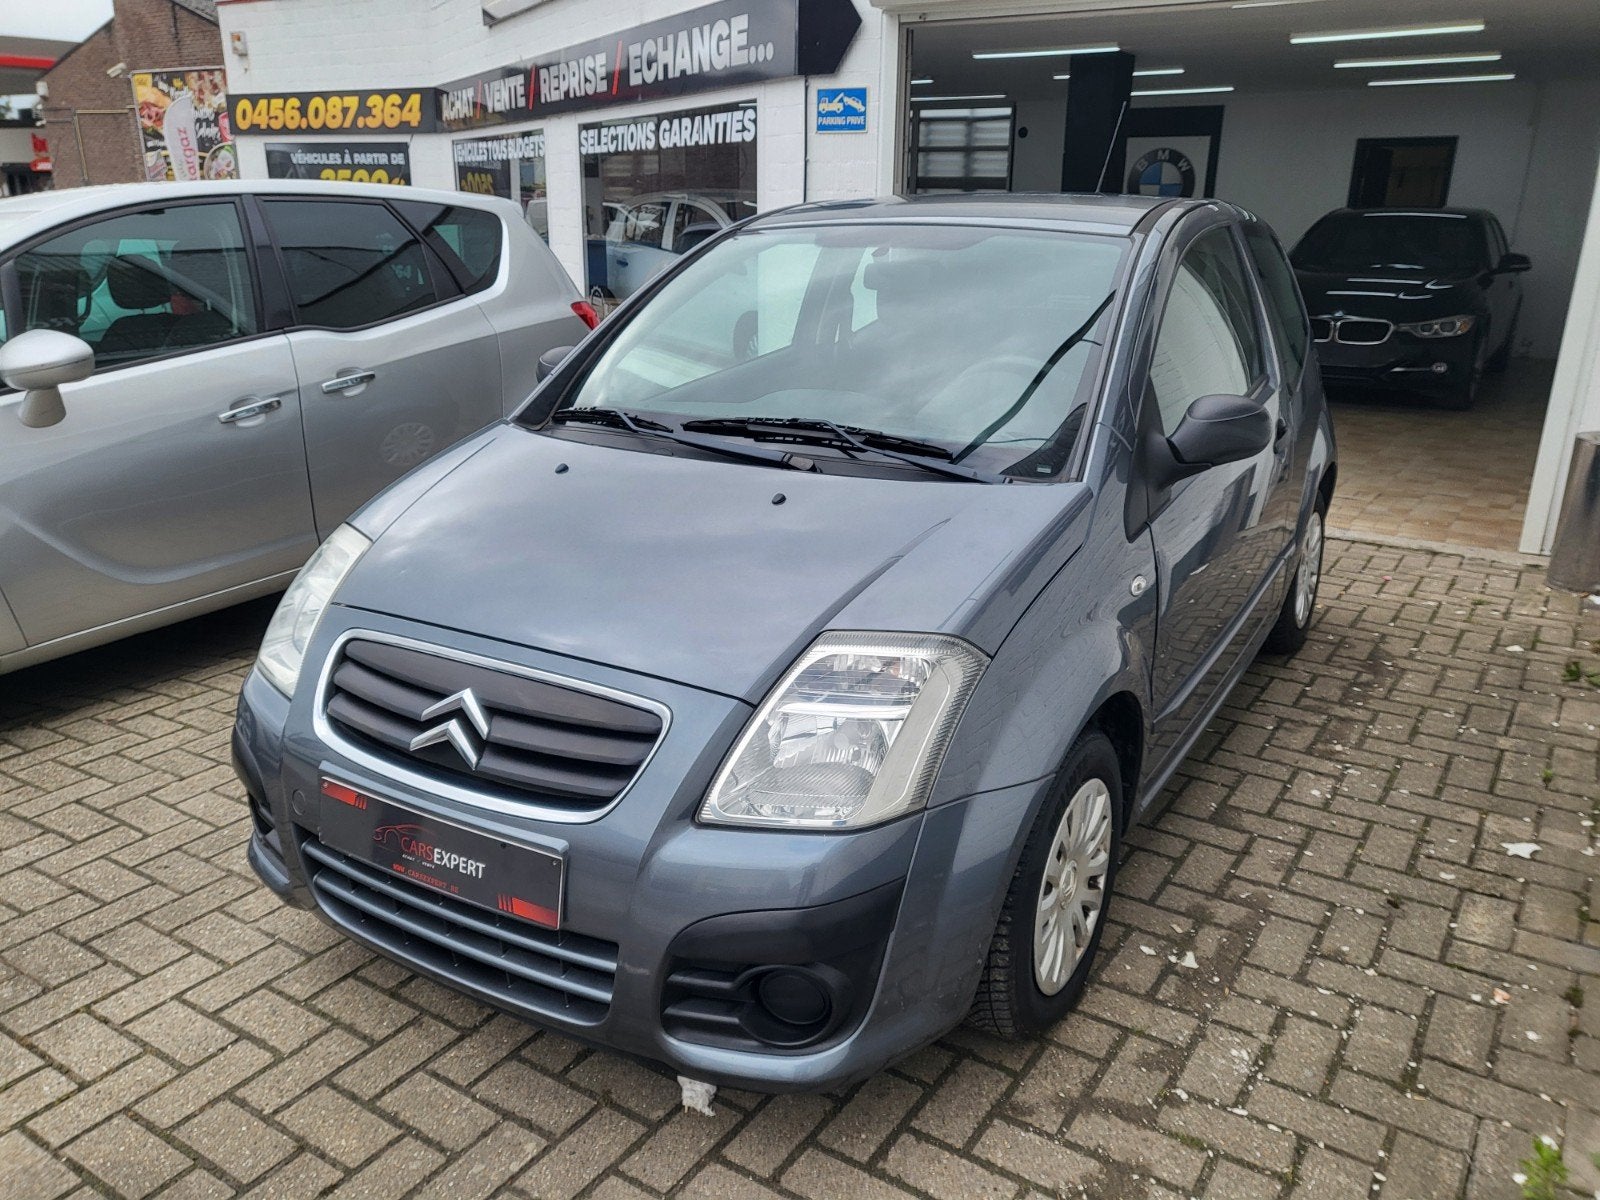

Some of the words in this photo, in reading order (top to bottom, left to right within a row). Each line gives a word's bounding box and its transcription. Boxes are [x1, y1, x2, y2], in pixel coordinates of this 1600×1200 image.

[442, 87, 474, 122] ACHAT
[484, 74, 526, 114] VENTE
[539, 52, 608, 104] REPRISE
[628, 14, 774, 87] ECHANGE...
[235, 93, 422, 130] 0456.087.364
[818, 116, 846, 125] PARKING
[487, 138, 508, 161] TOUS
[507, 134, 545, 159] BUDGETS
[580, 121, 656, 155] SELECTIONS
[659, 108, 756, 149] GARANTIES
[290, 149, 342, 165] VÉHICULES
[354, 152, 389, 165] PARTIR
[390, 153, 406, 166] DE
[1136, 149, 1192, 172] BMW
[401, 837, 486, 879] CARSEXPERT
